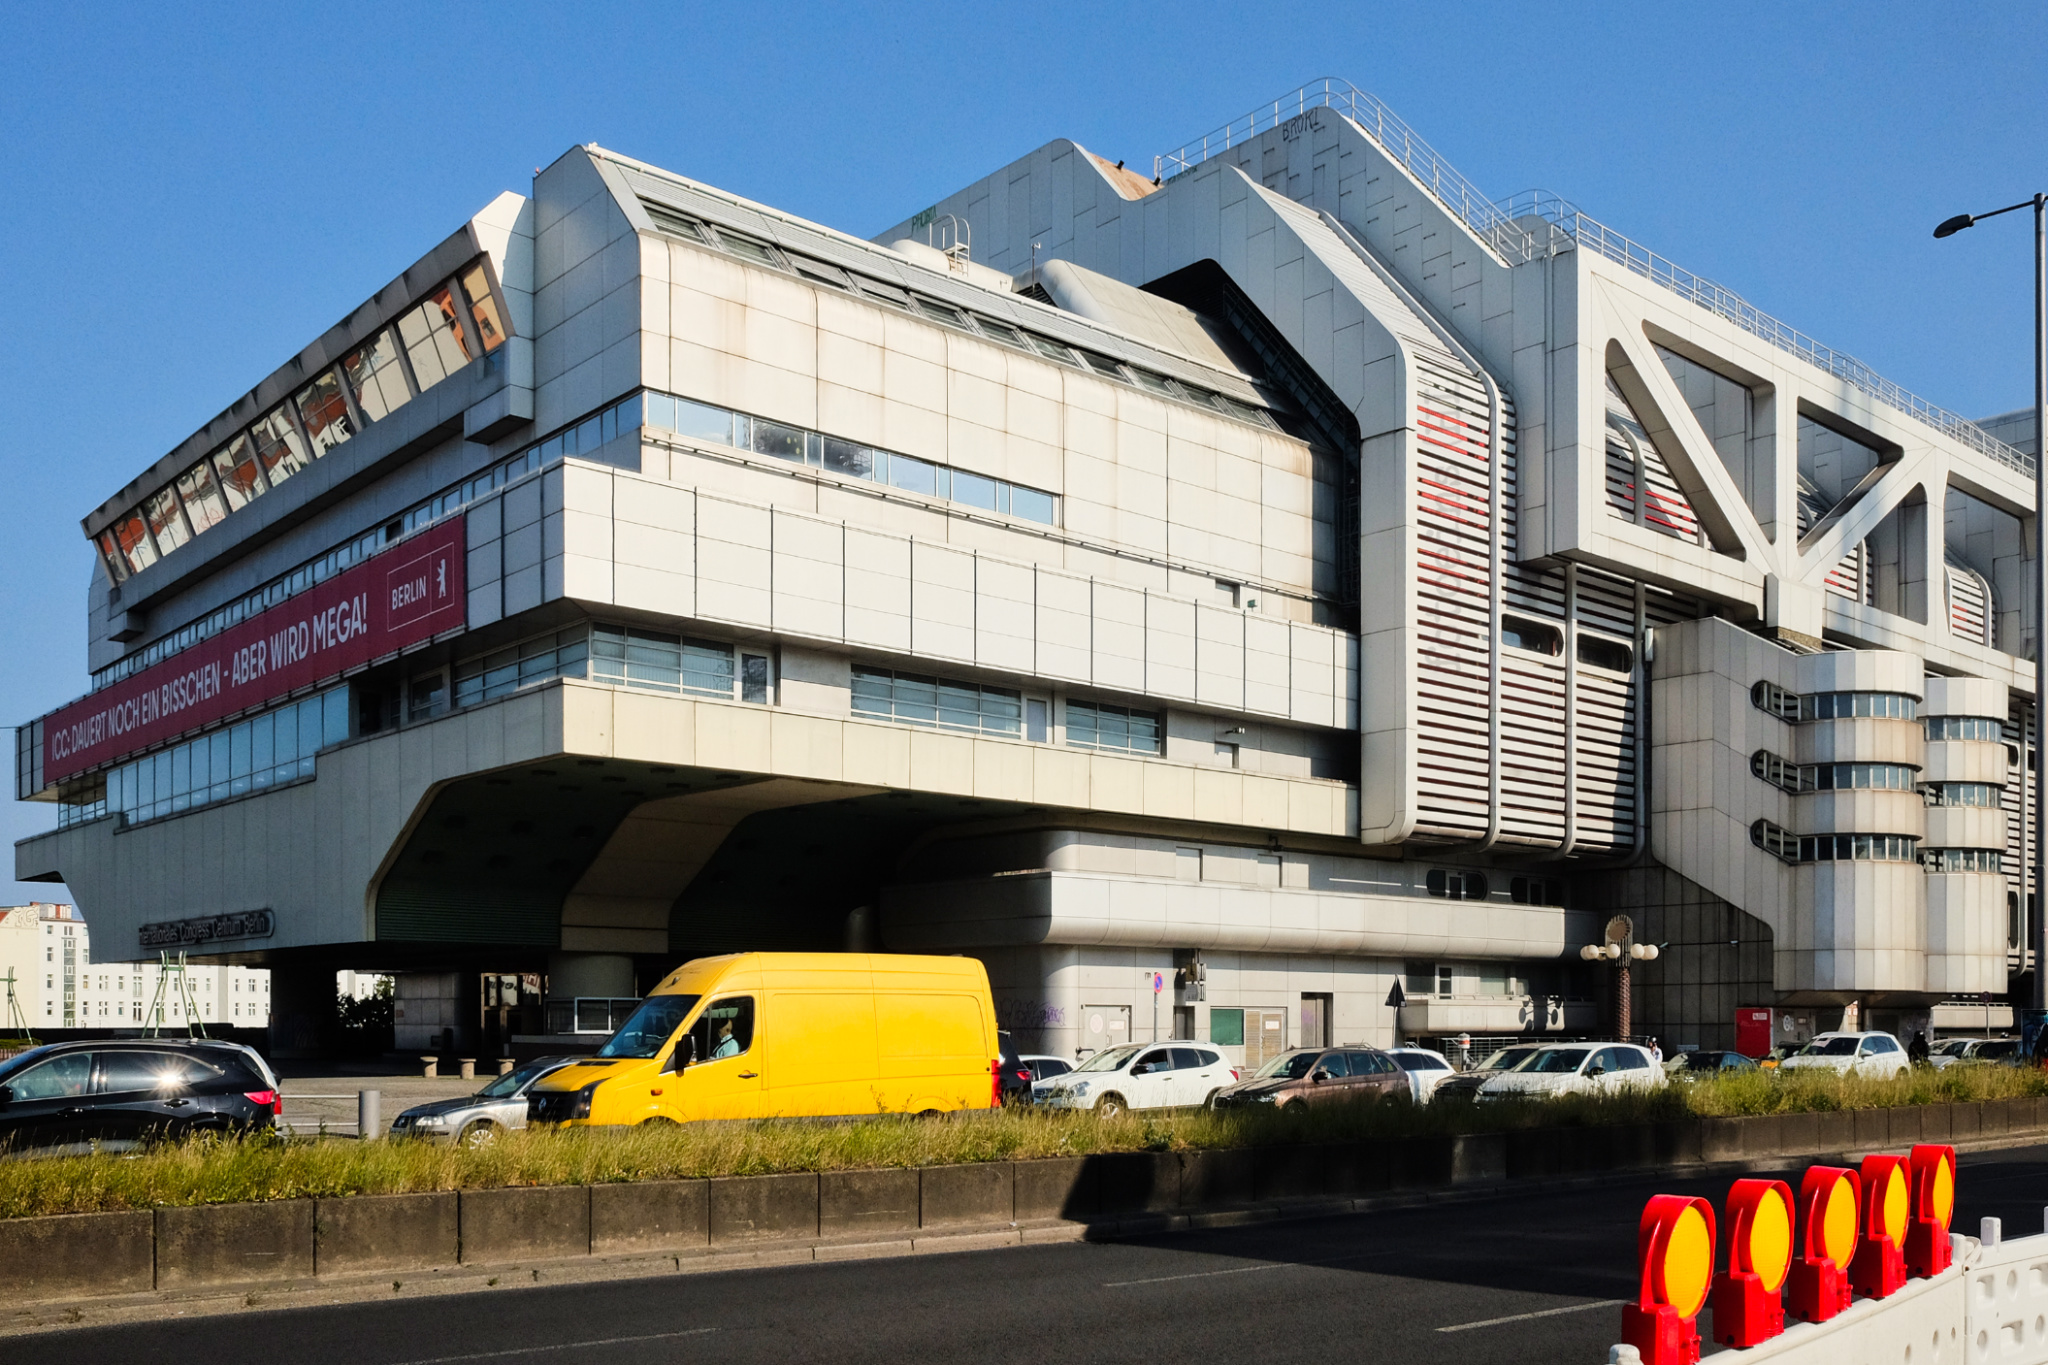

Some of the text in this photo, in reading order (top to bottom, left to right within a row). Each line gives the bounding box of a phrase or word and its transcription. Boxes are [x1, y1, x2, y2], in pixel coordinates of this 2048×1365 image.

[392, 575, 426, 611] BERLIN
[52, 728, 71, 761] ICC:
[72, 710, 107, 754] DAUERT
[108, 698, 140, 738] NOCH
[142, 687, 160, 725] EIN
[162, 660, 220, 717] BISSCHEN
[231, 639, 267, 688] ABER
[270, 620, 309, 671] WIRD
[313, 592, 367, 653] MEGA!
[180, 921, 210, 943] Congress
[212, 917, 241, 937] Centrum
[244, 914, 265, 932] Berlin
